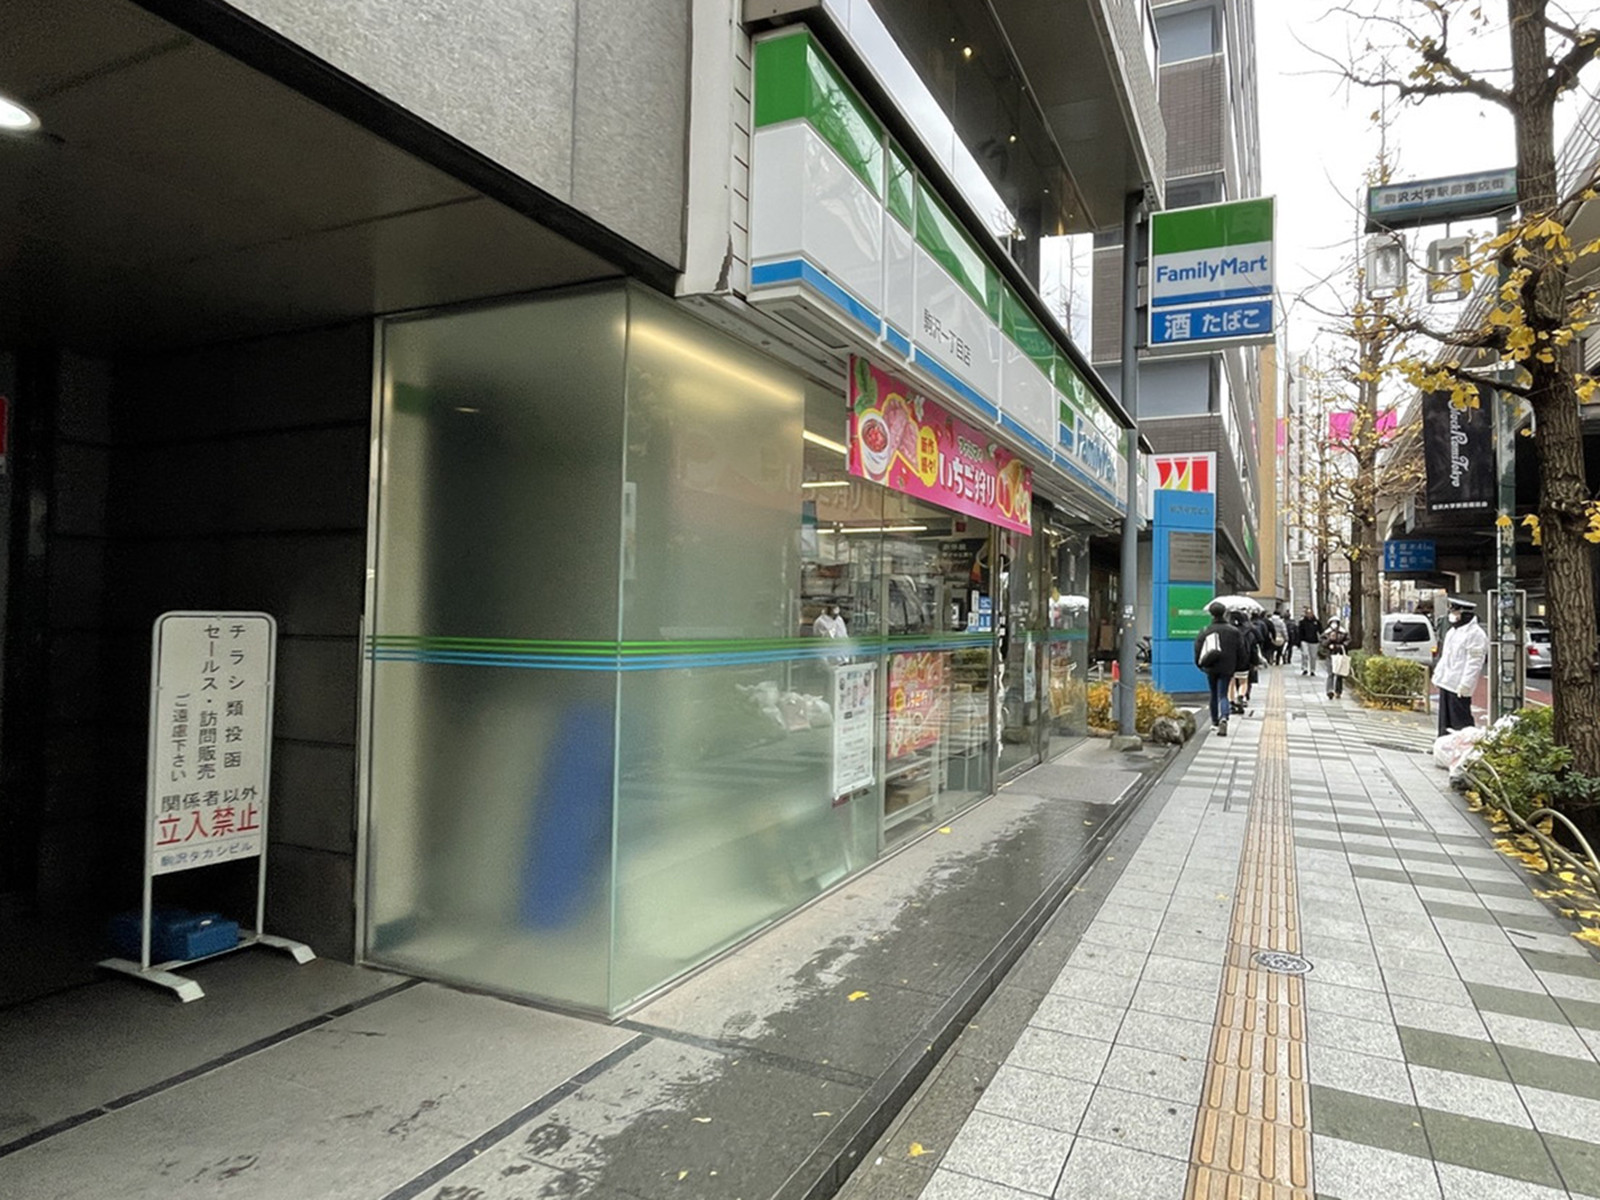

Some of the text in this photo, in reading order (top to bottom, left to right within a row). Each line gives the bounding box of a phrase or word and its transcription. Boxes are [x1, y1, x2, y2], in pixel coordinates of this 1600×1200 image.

[1156, 255, 1267, 283] FamilyMart
[1164, 309, 1260, 340] 酒 たばこ
[939, 452, 995, 506] いちご狩り
[197, 624, 220, 781] セールス・訪問販売
[224, 624, 246, 768] チラシ類投函
[171, 693, 190, 782] ご遠慮下さい
[156, 802, 259, 846] 立入禁止
[161, 787, 258, 812] 関係者以外
